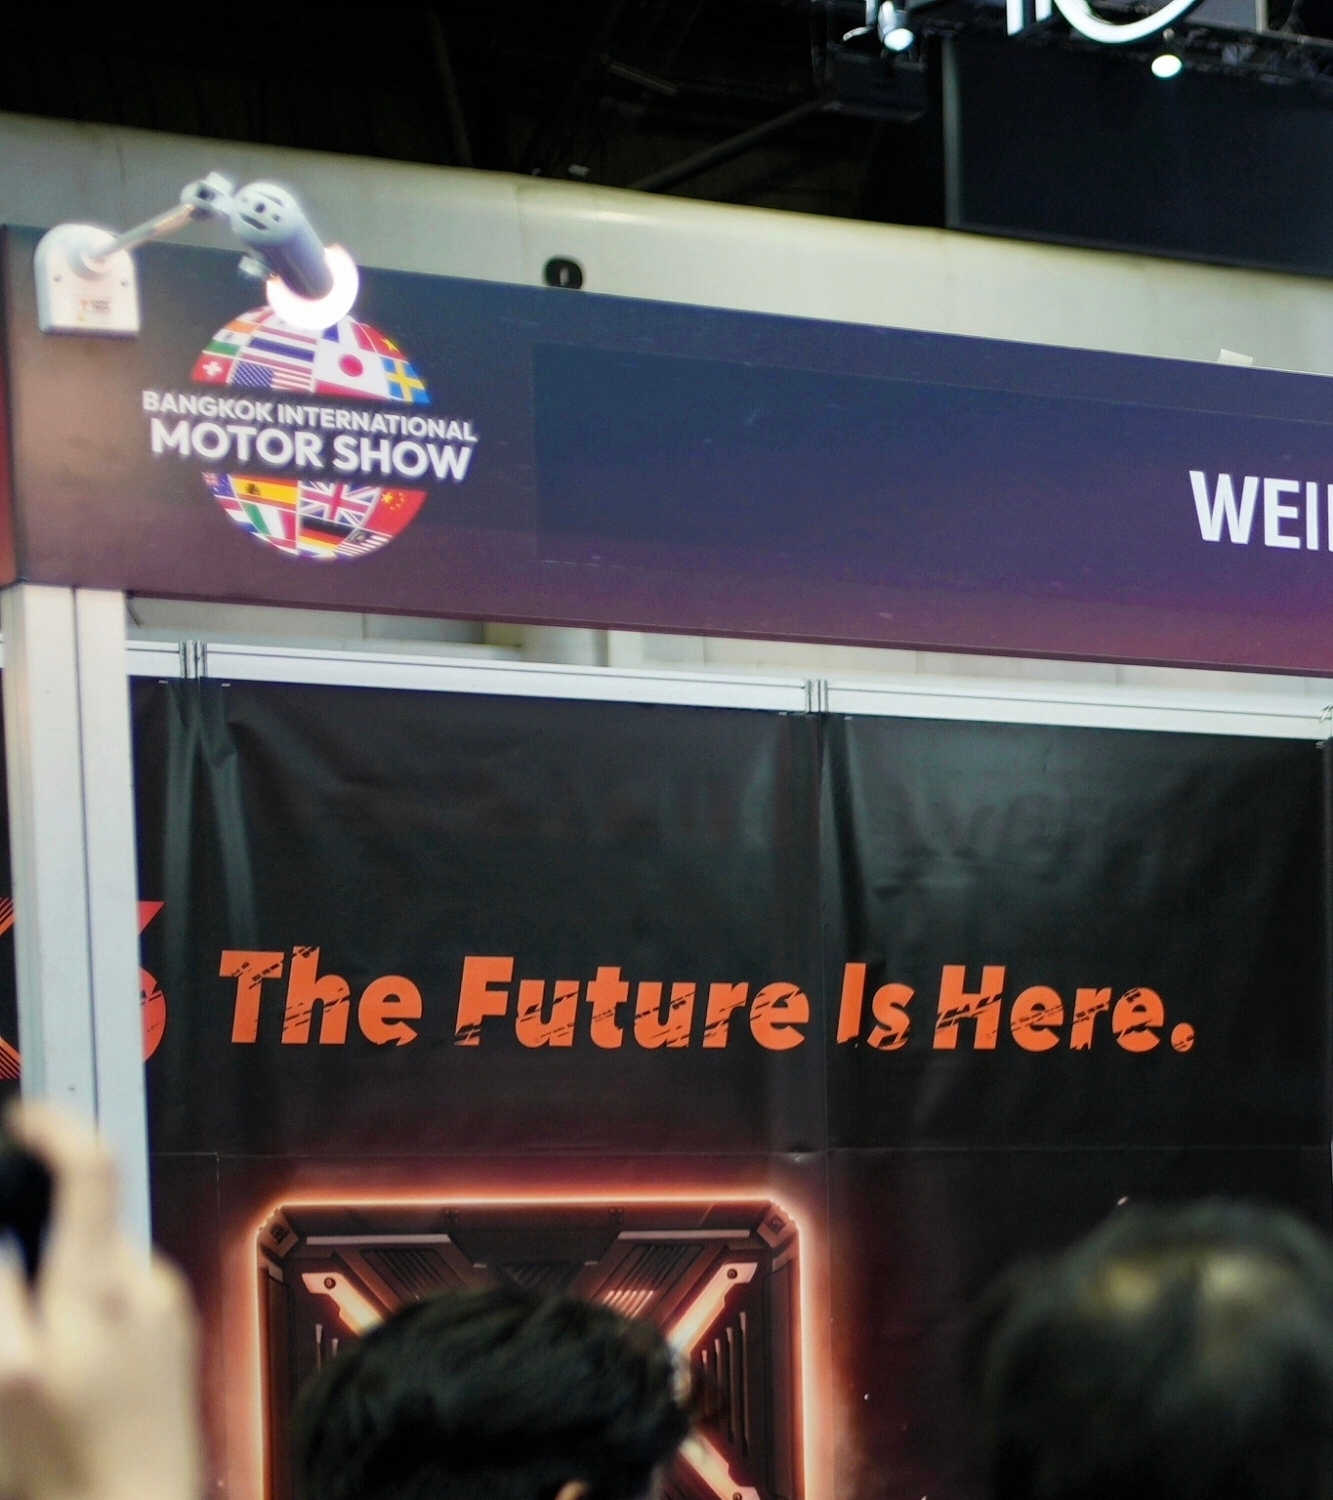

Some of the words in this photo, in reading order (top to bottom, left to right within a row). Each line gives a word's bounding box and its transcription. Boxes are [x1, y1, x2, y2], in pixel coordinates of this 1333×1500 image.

[142, 390, 274, 422] BANGKOK
[278, 403, 478, 443] INTERNATIONAL
[150, 417, 325, 469] MOTOR
[332, 433, 473, 482] SHOW
[219, 946, 422, 1046] The
[455, 955, 810, 1050] Future
[837, 962, 915, 1050] Is
[933, 964, 1195, 1053] Here.
